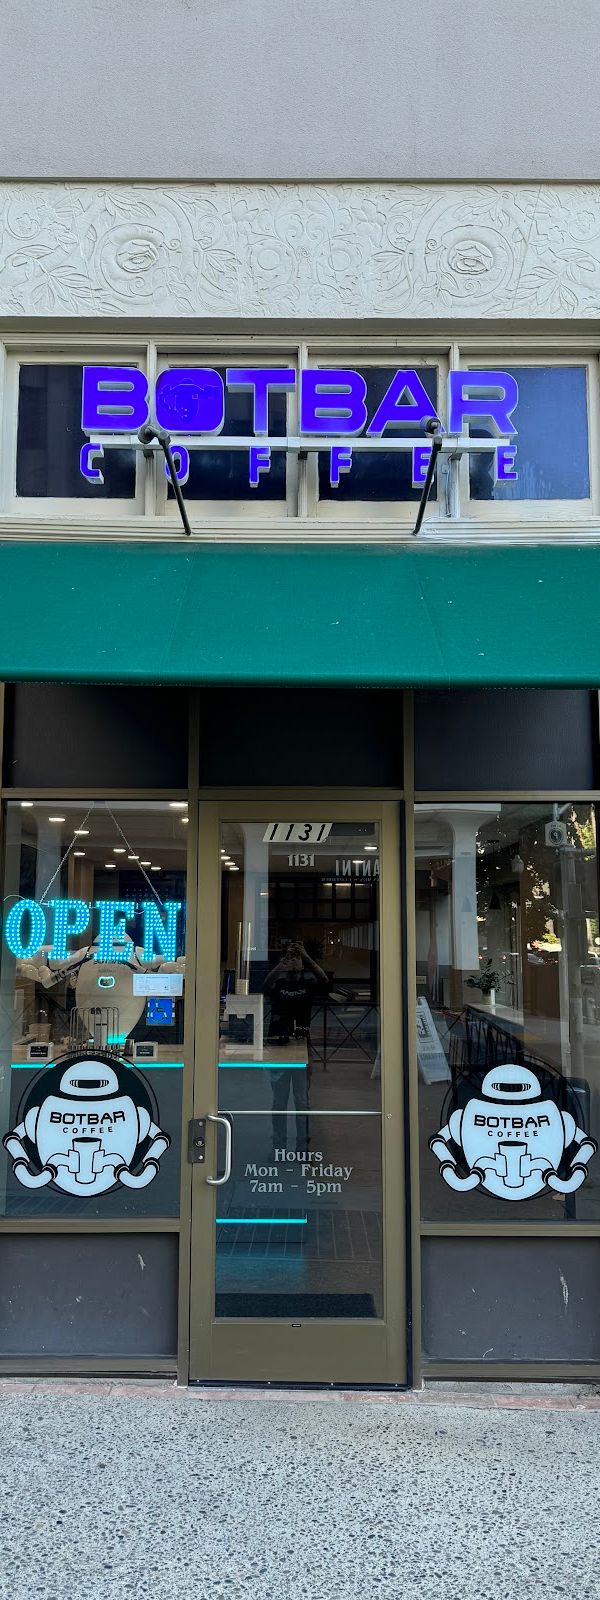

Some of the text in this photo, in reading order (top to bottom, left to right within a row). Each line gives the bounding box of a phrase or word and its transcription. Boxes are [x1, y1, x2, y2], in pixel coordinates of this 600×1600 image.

[81, 366, 519, 435] BOTBAR
[80, 443, 518, 485] COFFEE
[269, 824, 326, 841] 1131
[287, 853, 315, 867] 1131
[5, 899, 181, 961] OPEN
[50, 1111, 126, 1125] BOTBAR
[474, 1114, 550, 1128] BOTBAR
[274, 1148, 324, 1162] Hours
[244, 1164, 278, 1177] Mon
[301, 1163, 353, 1181] Friday
[249, 1180, 283, 1193] 7am
[306, 1180, 342, 1196] 5pm
